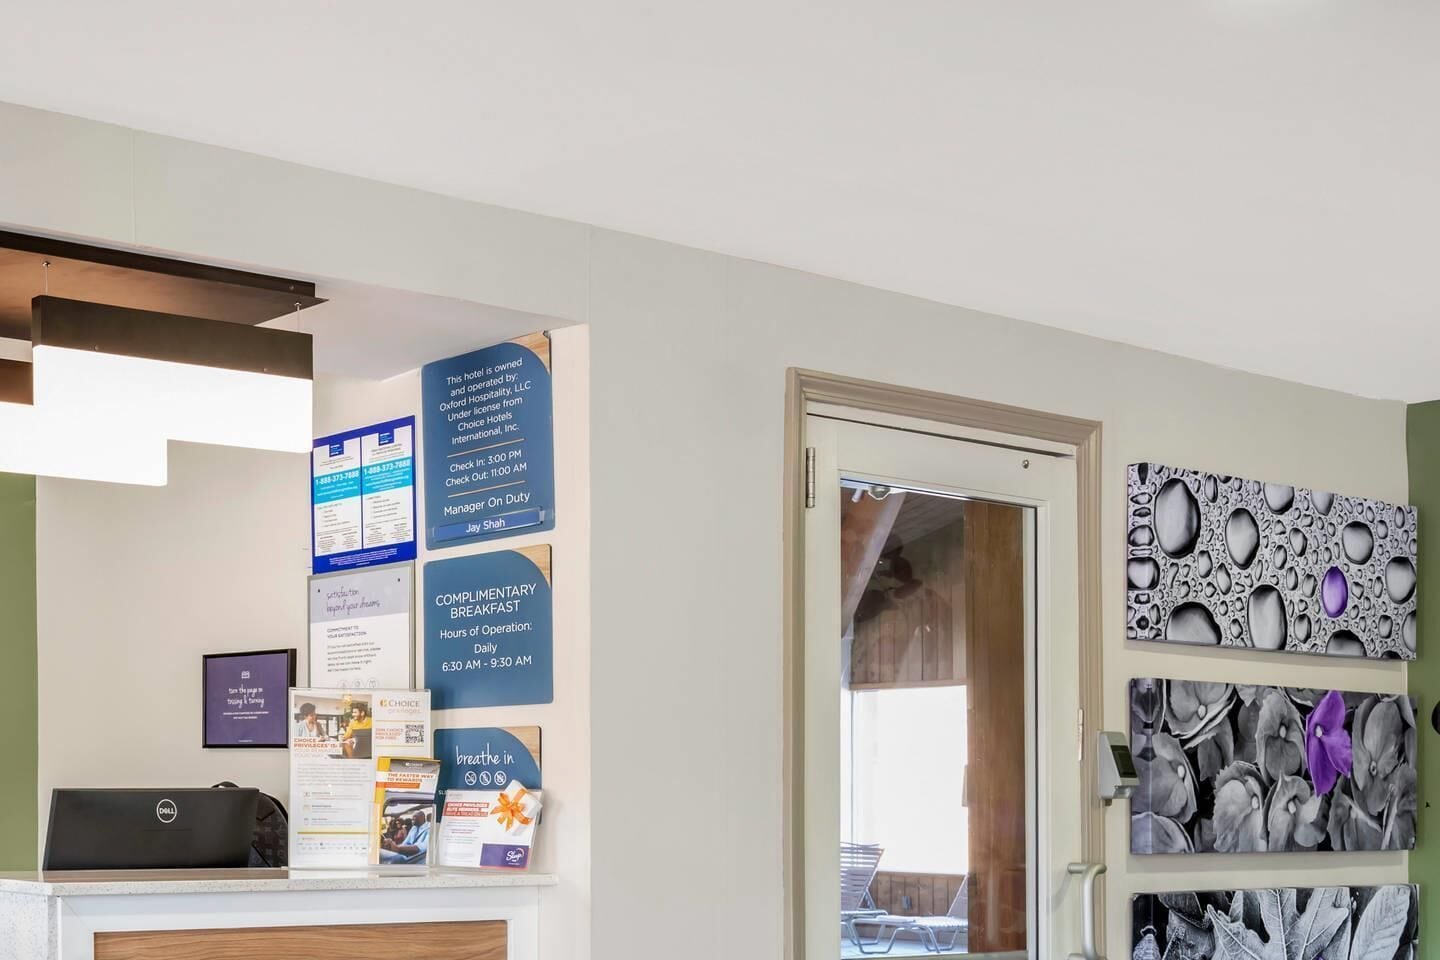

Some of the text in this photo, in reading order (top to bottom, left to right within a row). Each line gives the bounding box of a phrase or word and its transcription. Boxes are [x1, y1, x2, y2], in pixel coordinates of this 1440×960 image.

[447, 377, 462, 386] This
[464, 368, 484, 380] hotel
[495, 358, 522, 372] owned
[450, 373, 518, 396] and operated by:
[440, 381, 531, 411] Oxford Hospitality, LLC
[448, 397, 522, 421] Under license from
[458, 412, 512, 431] Choice Hotels
[452, 424, 519, 444] International, Inc.
[450, 461, 474, 472] Check
[488, 453, 506, 464] 3:00
[509, 450, 521, 460] PM
[446, 462, 527, 486] Check Out: 11:00 AM
[444, 492, 530, 516] Manager On Duty
[466, 518, 505, 533] Jay Shah
[436, 584, 536, 606] COMPLIMENTARY
[451, 600, 520, 618] BREAKFAST
[440, 622, 532, 640] Hours of Operation:
[474, 643, 497, 654] Daily
[442, 661, 462, 671] 6:30
[465, 660, 480, 669] AM
[491, 657, 512, 668] 9:30
[515, 656, 532, 666] AM
[456, 742, 515, 765] breathe in
